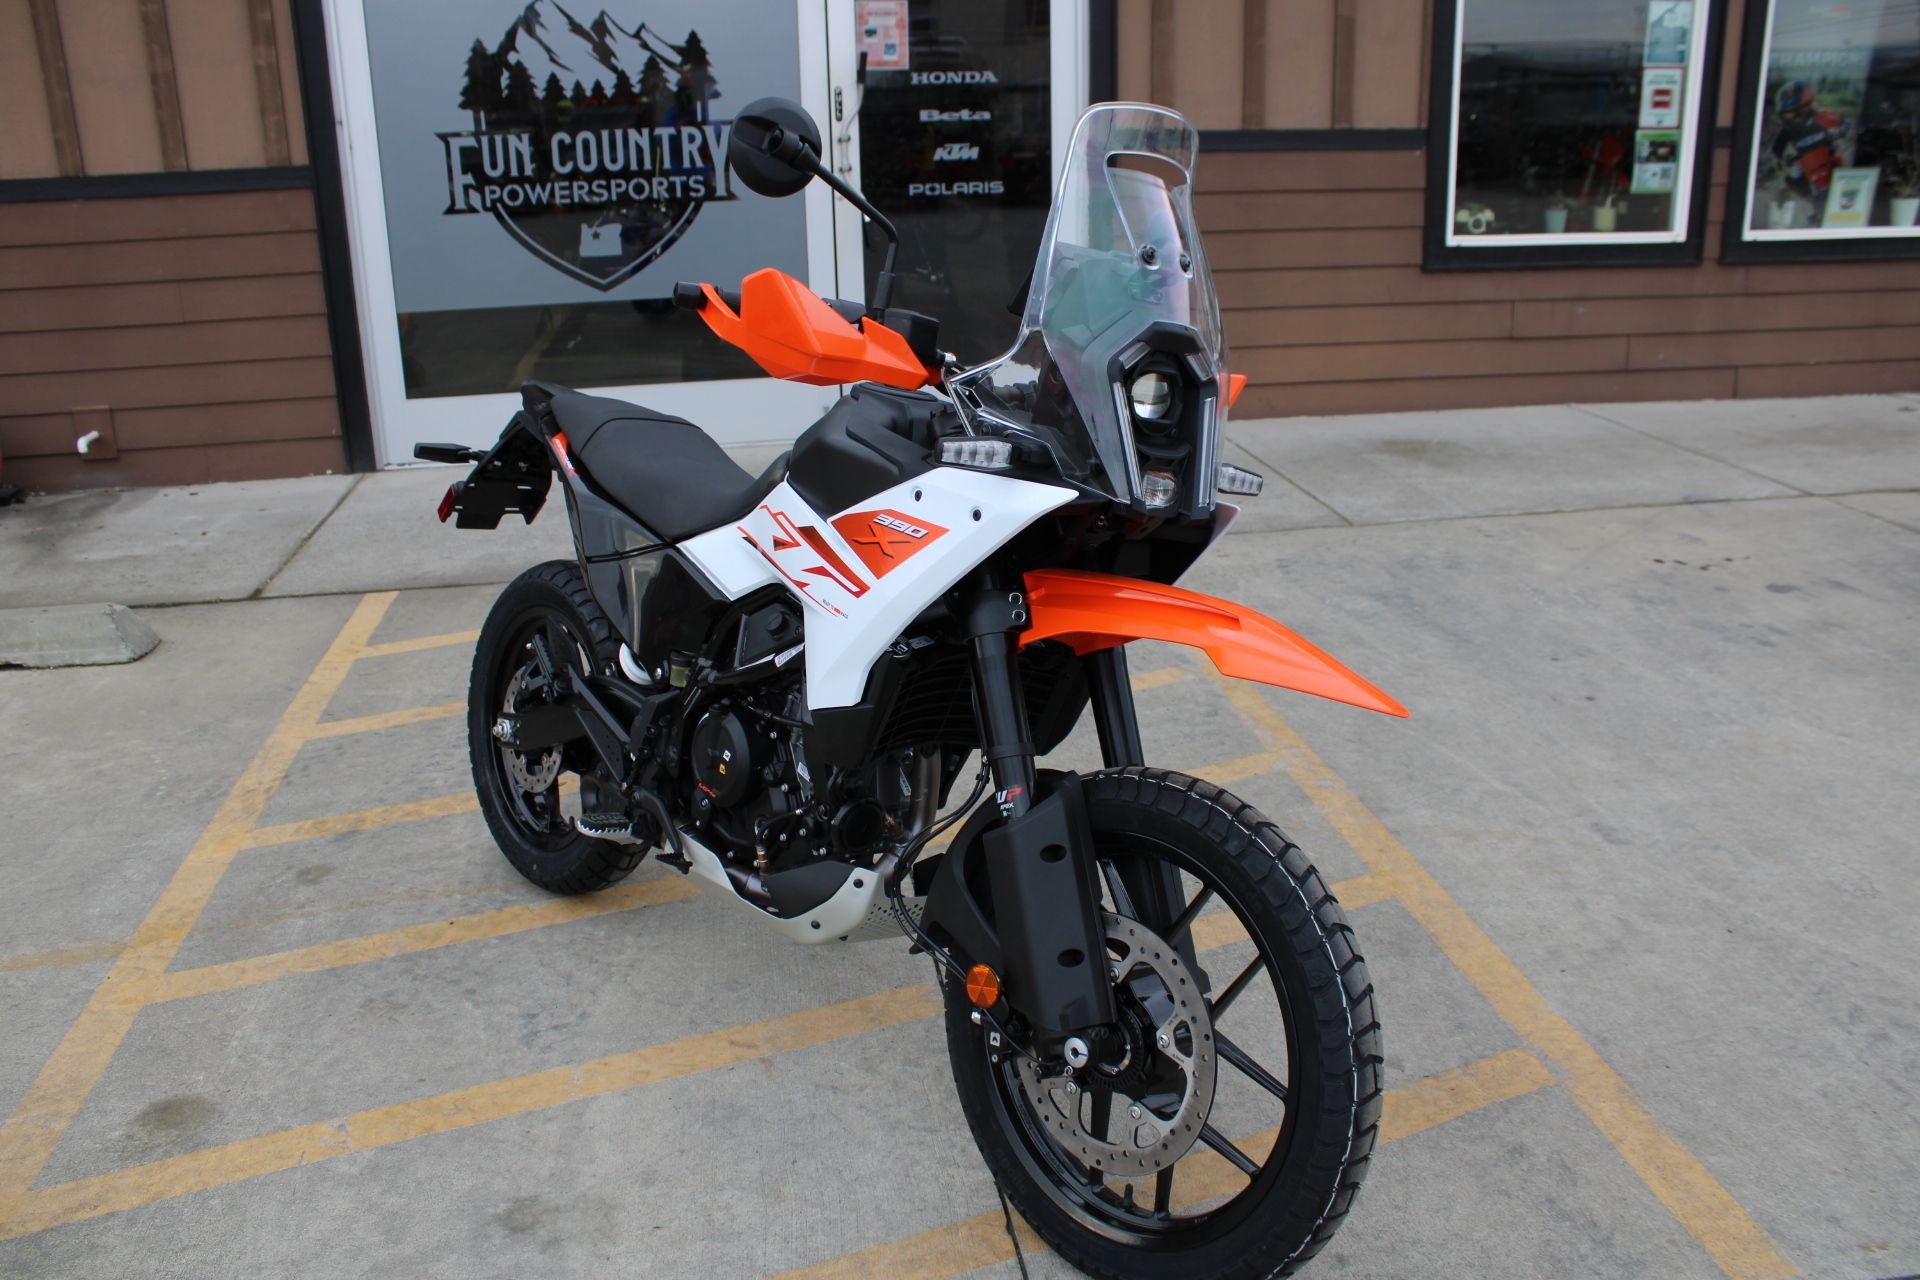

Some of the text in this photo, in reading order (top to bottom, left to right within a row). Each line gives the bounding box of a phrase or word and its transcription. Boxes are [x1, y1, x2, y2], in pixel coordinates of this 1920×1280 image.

[910, 71, 999, 85] HONDA
[919, 109, 992, 122] Beta
[933, 143, 981, 161] KTM
[446, 120, 734, 211] FUN COUNTRY
[484, 175, 706, 208] POWERSPORTS
[909, 181, 1005, 197] POLARIS
[873, 513, 929, 540] 390
[851, 523, 914, 560] X
